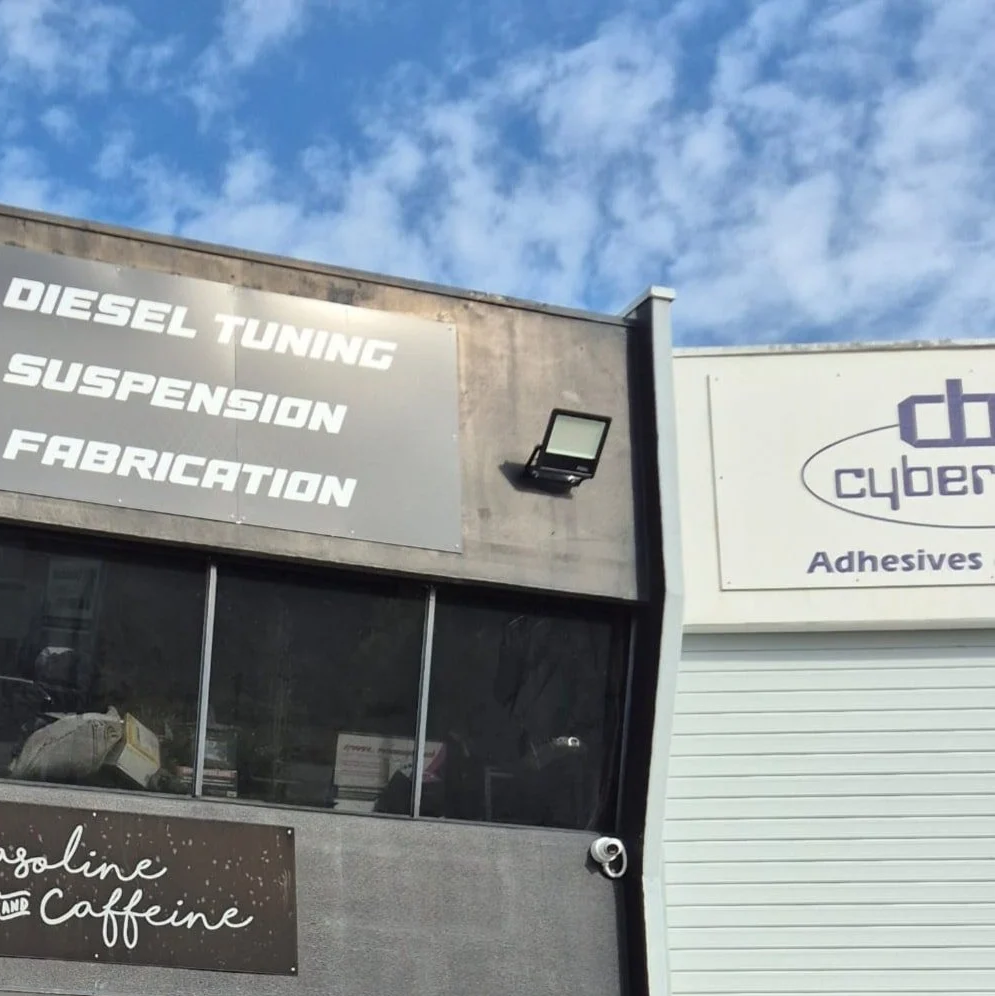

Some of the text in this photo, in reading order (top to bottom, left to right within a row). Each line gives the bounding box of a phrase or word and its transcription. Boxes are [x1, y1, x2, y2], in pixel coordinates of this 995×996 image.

[3, 277, 397, 370] DIESEL TUNING
[3, 353, 347, 434] SUSPENSION
[3, 429, 357, 508] FABRICATION
[806, 549, 983, 575] Adhesives
[0, 896, 30, 915] AND
